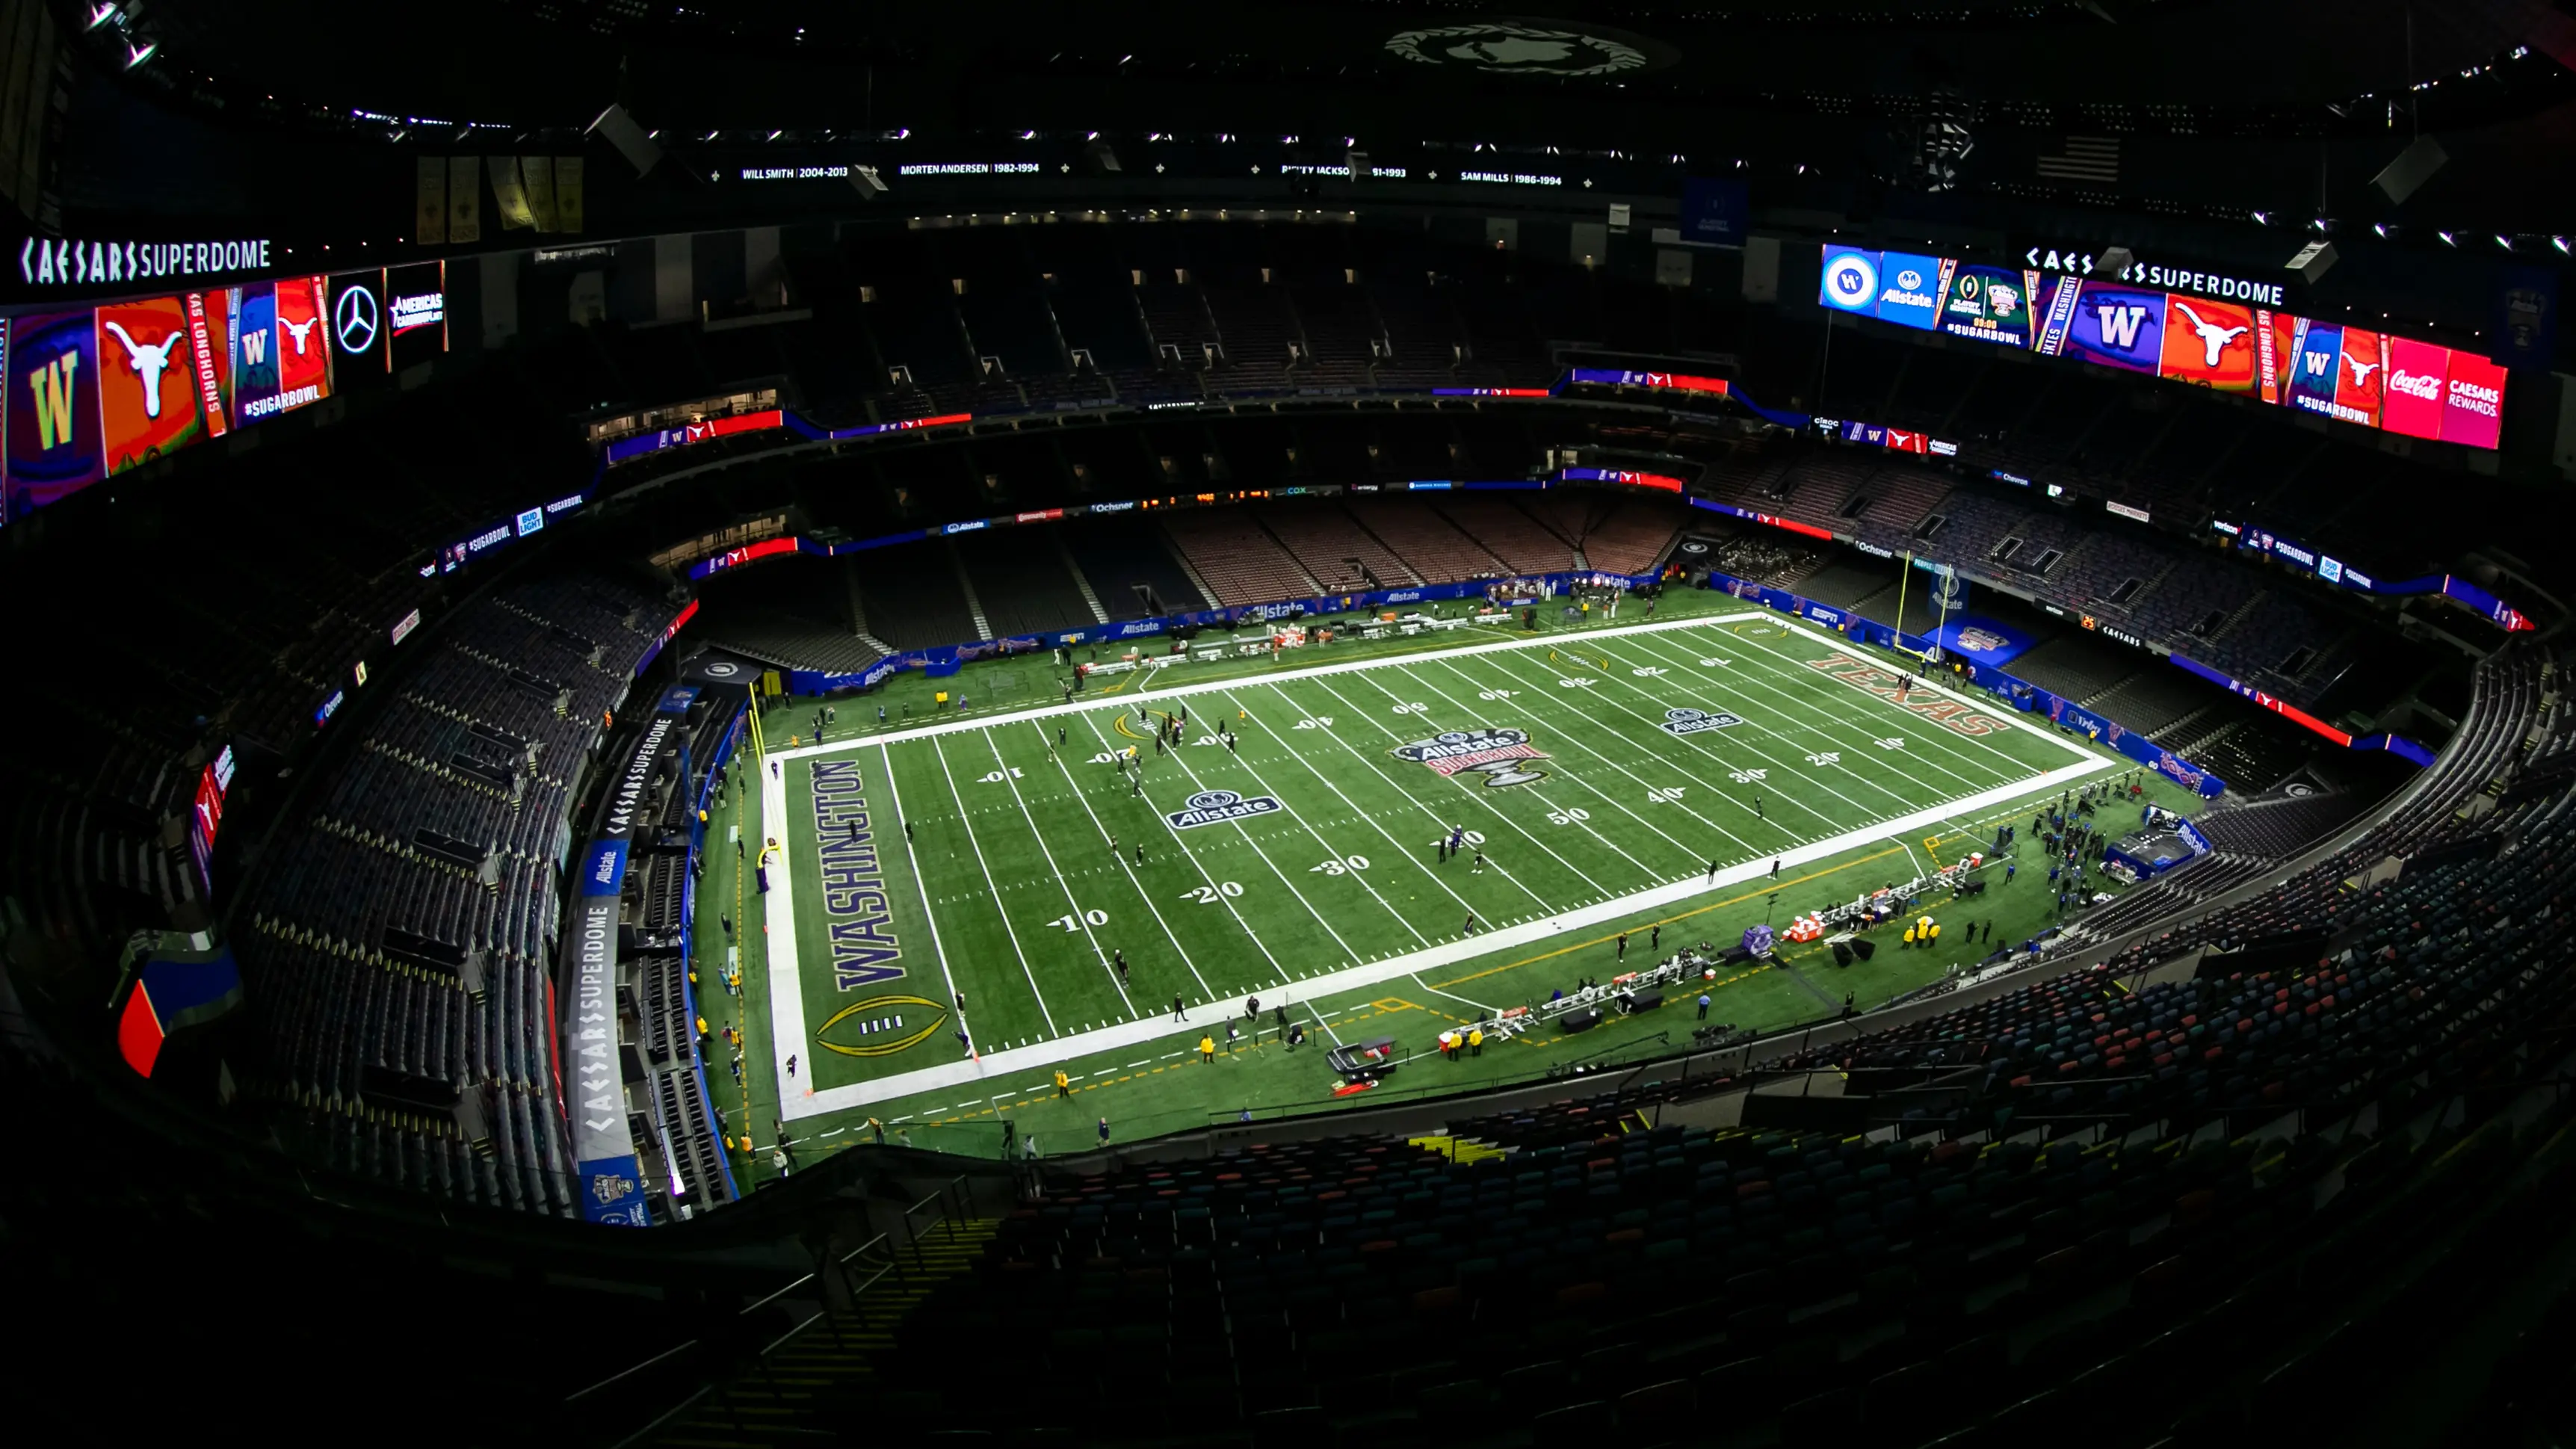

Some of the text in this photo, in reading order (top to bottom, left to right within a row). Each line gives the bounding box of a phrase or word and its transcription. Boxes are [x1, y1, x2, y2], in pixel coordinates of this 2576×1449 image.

[742, 167, 848, 179] WILL SMITH 2004-2013
[901, 164, 1039, 175] MORTEN ANDERSEN 1982-1994
[1282, 165, 1314, 174] REY
[1317, 167, 1350, 176] JACKSO
[1461, 172, 1561, 185] SAM MILLS 1986-1994
[22, 236, 270, 284] CAESARS SUPERDOME
[2026, 247, 2283, 306] CAESS SUPERDOME
[1948, 324, 2021, 345] #SUGARBOWL
[2098, 306, 2146, 347] W
[242, 329, 268, 365] W
[194, 321, 221, 413] LONGHORNS
[2259, 328, 2276, 388] LONGHORNS
[2305, 351, 2331, 376] W
[30, 349, 78, 450] W
[245, 385, 320, 416] #SUGARBOWL
[2449, 380, 2499, 404] CAESARS
[2297, 395, 2369, 424] #SUGARBOWL
[1868, 430, 1882, 441] W
[2003, 473, 2028, 486] Chevron
[1096, 501, 1133, 512] Ochsner
[520, 519, 541, 534] LIGHT
[522, 511, 537, 523] BUD
[2214, 520, 2237, 535] verizon
[469, 525, 510, 552] #SUGARBOWL
[1859, 542, 1892, 558] Ochsner
[2276, 541, 2314, 566] #SUGARBOWL
[2321, 566, 2339, 579] LIGHT
[2325, 560, 2338, 569] BUD
[1388, 592, 1419, 603] Allstate
[1811, 607, 1838, 623] ESPN
[2083, 616, 2094, 628] 25
[1122, 622, 1158, 634] Allstate
[2103, 626, 2140, 647] CAESARS
[1559, 677, 1591, 688] 30
[1479, 689, 1510, 701] 40
[1806, 652, 2011, 736] TEXAS
[1392, 702, 1429, 714] 50
[1299, 717, 1333, 729] 40
[1673, 717, 1734, 732] Allstate
[631, 719, 672, 774] SUPERDOME
[1421, 735, 1513, 760] Allstate
[1805, 752, 1840, 766] 20
[986, 767, 1025, 782] 10
[1729, 769, 1766, 783] 30
[1648, 787, 1683, 803] 40
[607, 776, 645, 835] CAESARS
[1179, 802, 1270, 826] Allstate
[1547, 808, 1590, 825] 50
[2178, 824, 2206, 856] Allstate
[596, 850, 617, 884] Allstate
[1321, 855, 1370, 875] 30
[809, 759, 907, 992] WASHINGTON
[1193, 881, 1244, 903] 20
[1060, 909, 1108, 933] 10
[580, 906, 608, 1009] SUPERDOME
[579, 1013, 616, 1131] CAESARS
